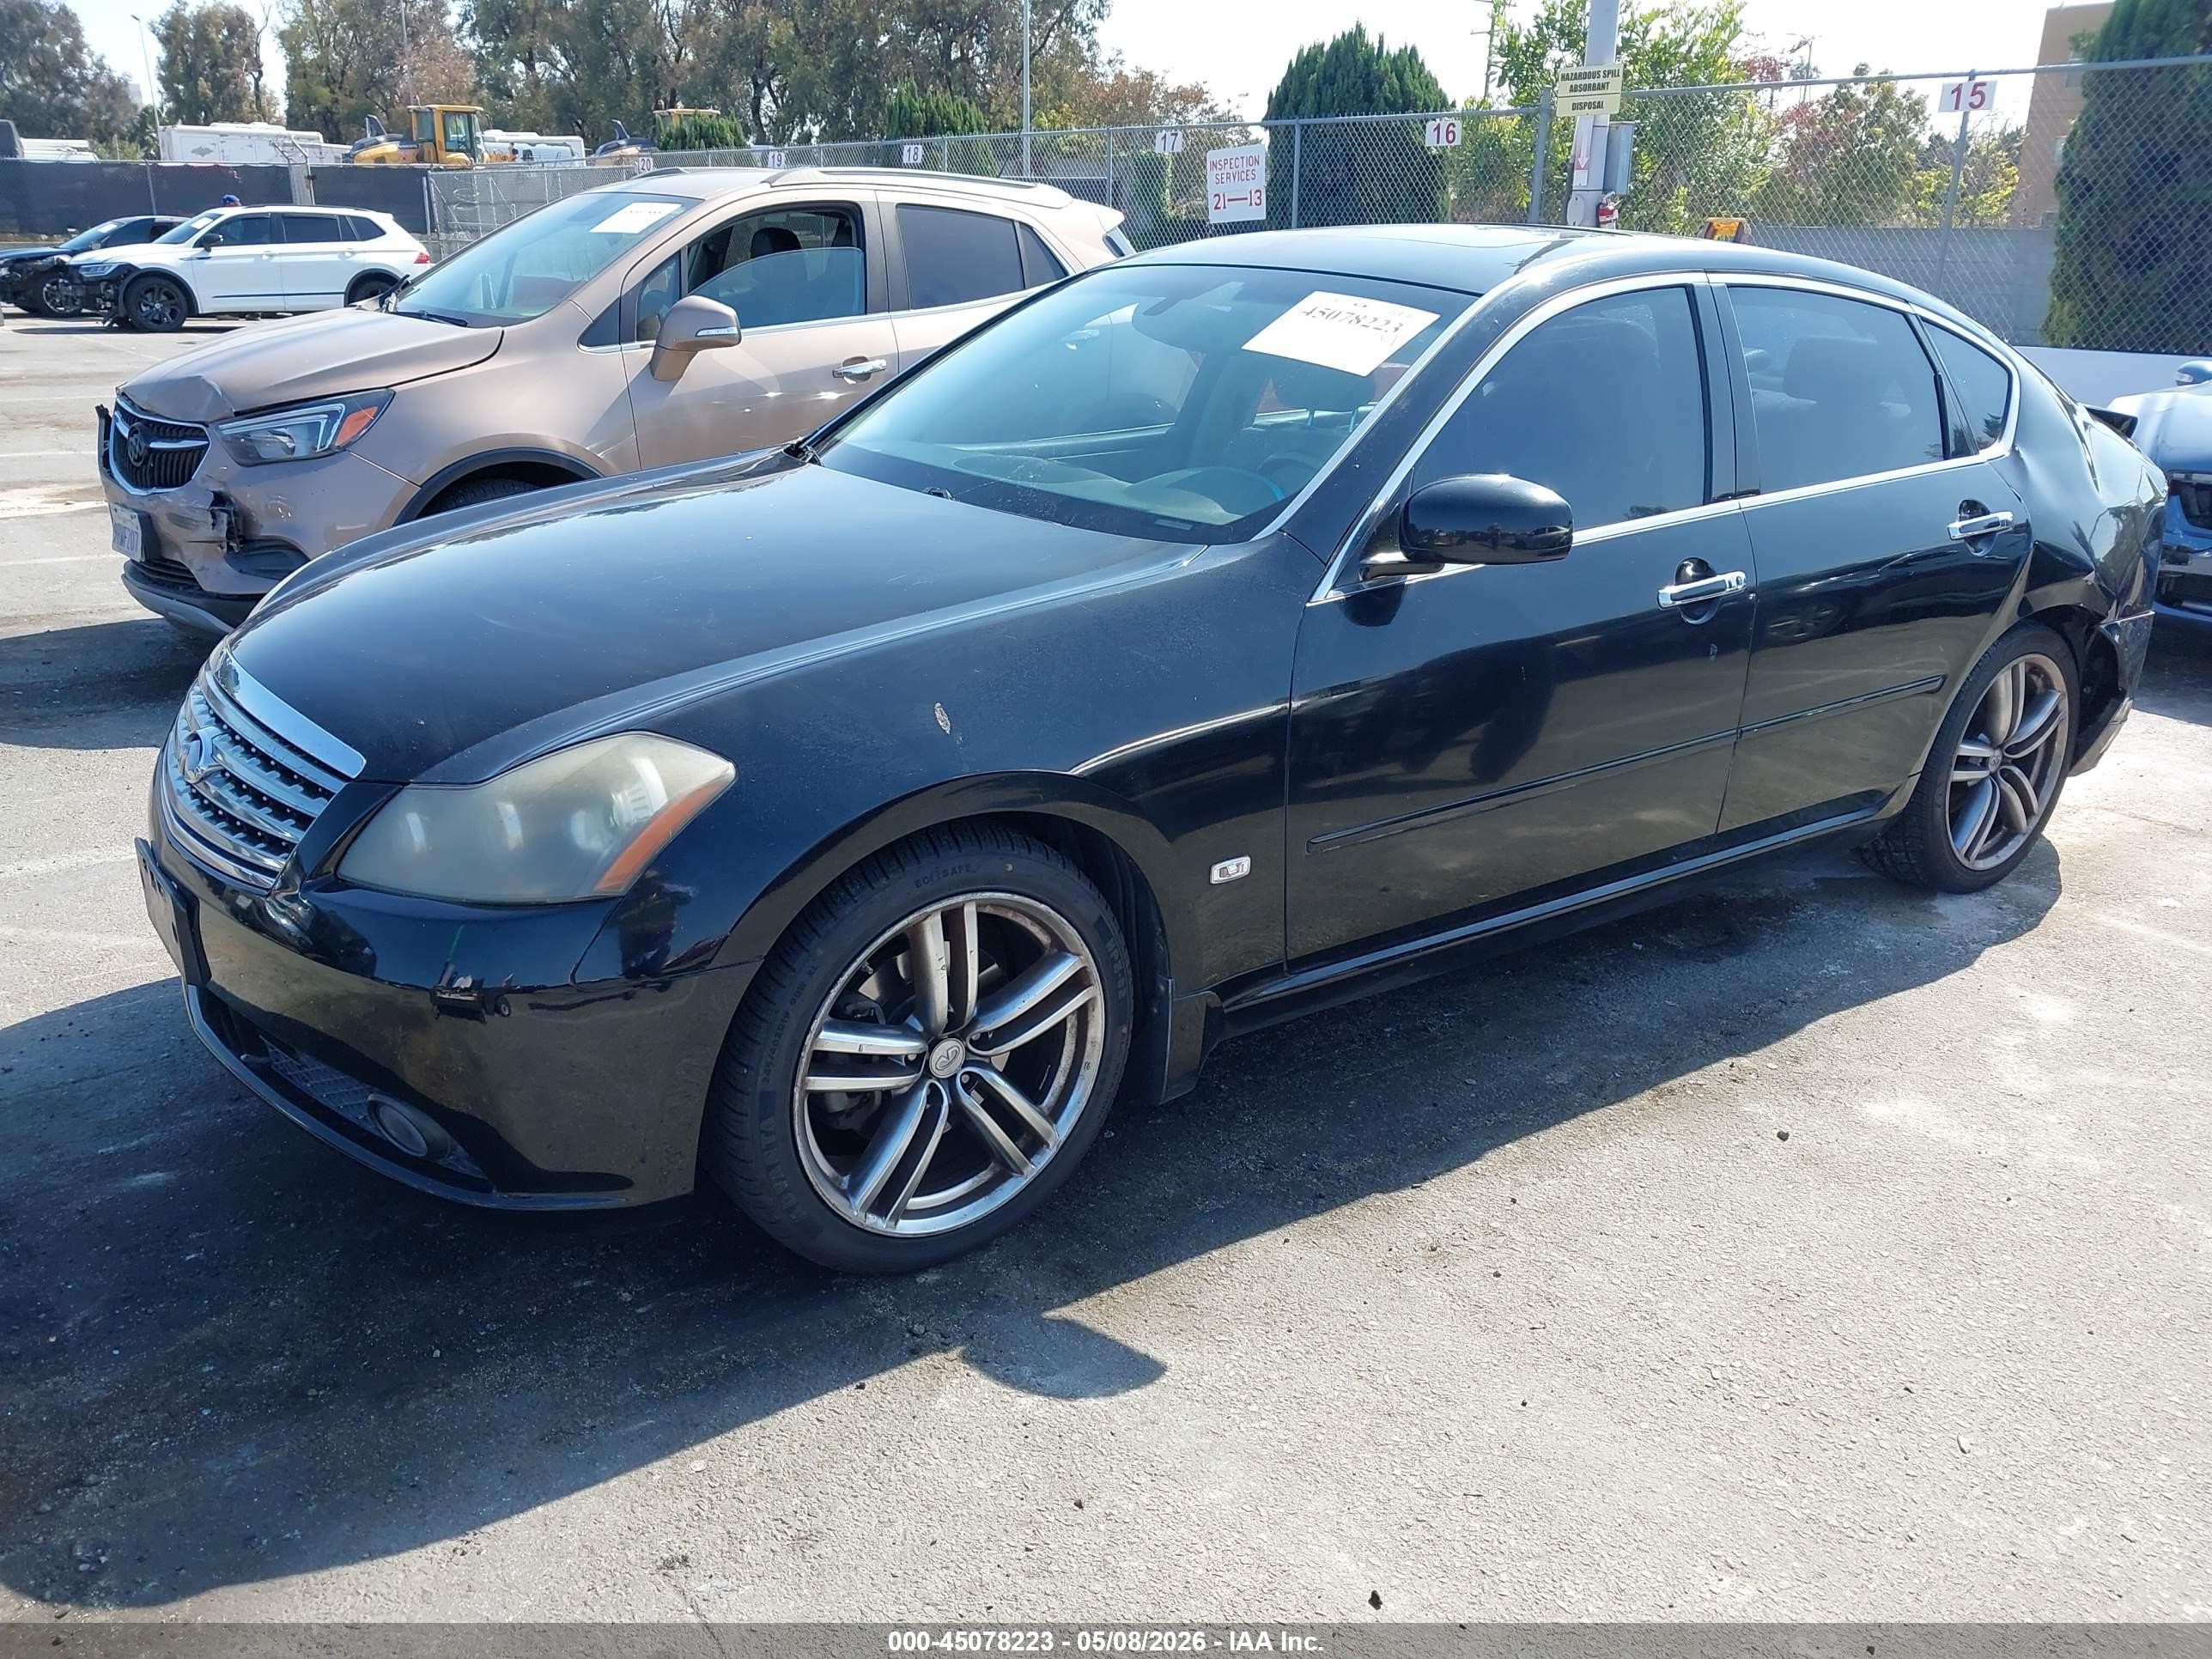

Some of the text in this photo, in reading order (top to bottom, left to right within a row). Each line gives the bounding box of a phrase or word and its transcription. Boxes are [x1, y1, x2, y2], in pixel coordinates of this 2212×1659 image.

[1560, 69, 1620, 82] HAZARDOUS SPILL
[1569, 82, 1610, 94] ABSORBANT
[1951, 82, 1987, 110] 15
[1571, 100, 1604, 111] DISPOSAL
[1433, 122, 1456, 144] 16
[1161, 132, 1178, 152] 17
[771, 153, 782, 167] 19
[907, 146, 919, 162] 18
[641, 158, 651, 172] 20
[1210, 155, 1260, 172] INSPECTION
[1215, 169, 1256, 185] SERVICES
[1302, 306, 1404, 333] 45078223
